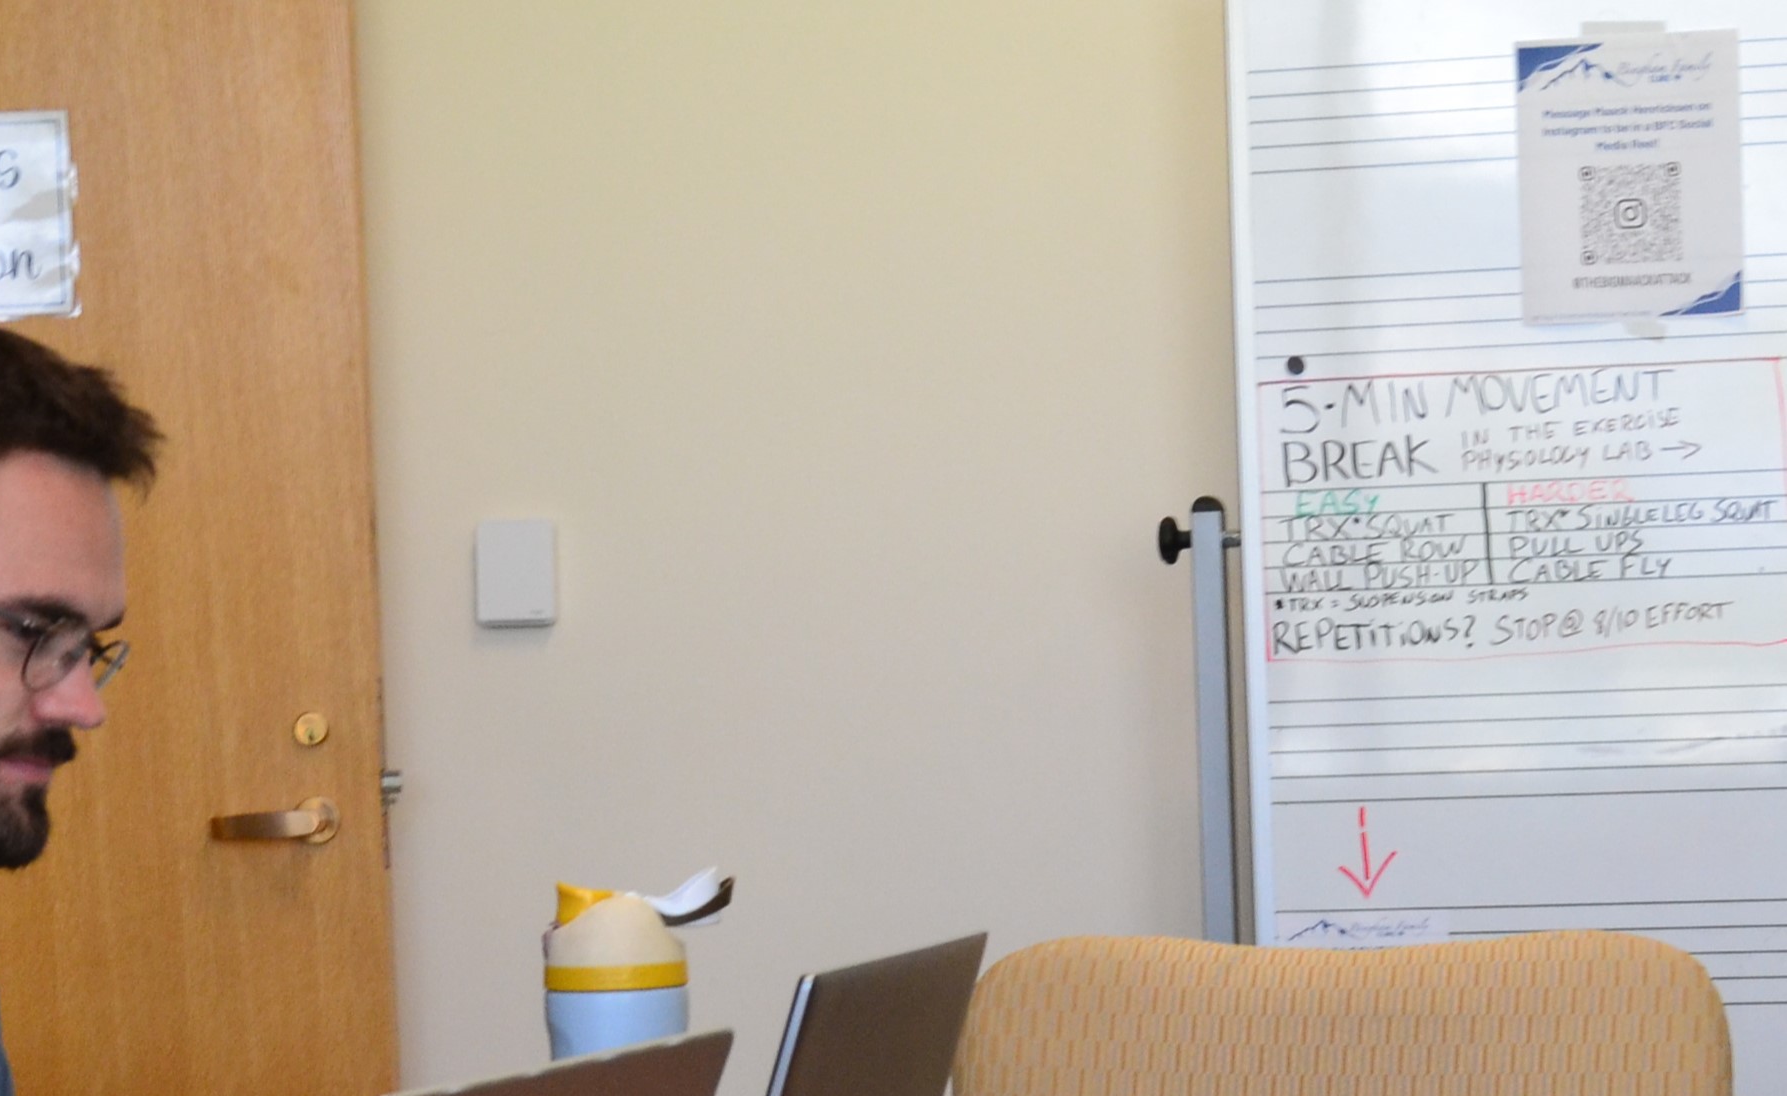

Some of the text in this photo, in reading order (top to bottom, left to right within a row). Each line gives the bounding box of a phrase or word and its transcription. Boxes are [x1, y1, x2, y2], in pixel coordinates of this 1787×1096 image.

[1444, 369, 1676, 418] MOVEMENT
[1461, 430, 1490, 447] IN
[1508, 420, 1562, 442] THE
[1282, 434, 1440, 488] BREAK
[1601, 440, 1652, 463] LAB
[1296, 488, 1380, 519] EASY
[1506, 478, 1635, 505] HARDER
[1365, 512, 1456, 540] SQUAT
[1712, 499, 1779, 523] SQUAT
[1282, 535, 1467, 568] CABLE ROW
[1508, 529, 1645, 559] PULL UPS
[1279, 559, 1479, 594] WALL PUSH-UP
[1508, 553, 1673, 585] CABLE FLY
[1467, 586, 1530, 604] STRAPS
[1645, 600, 1735, 630] EFFORT
